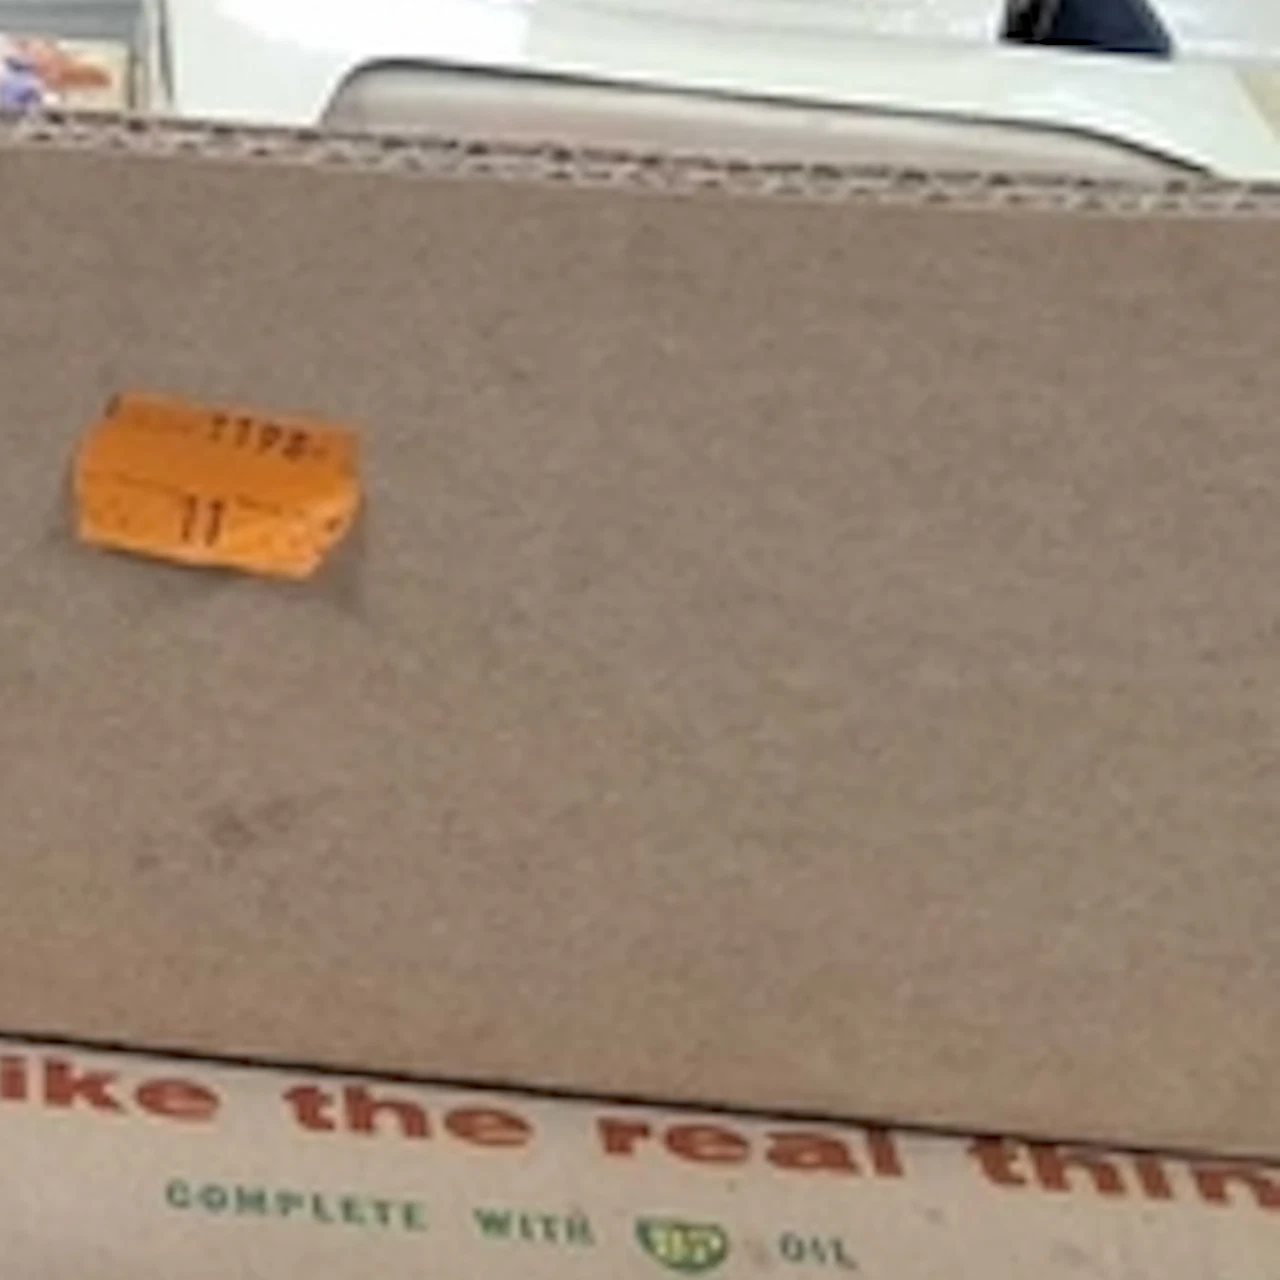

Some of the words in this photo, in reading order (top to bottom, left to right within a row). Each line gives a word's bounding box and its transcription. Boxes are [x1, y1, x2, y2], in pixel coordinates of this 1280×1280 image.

[282, 1084, 534, 1147] the
[597, 1115, 906, 1178] real
[164, 1179, 429, 1232] COMPLETE
[472, 1206, 595, 1247] WITH
[778, 1231, 859, 1272] OIL
